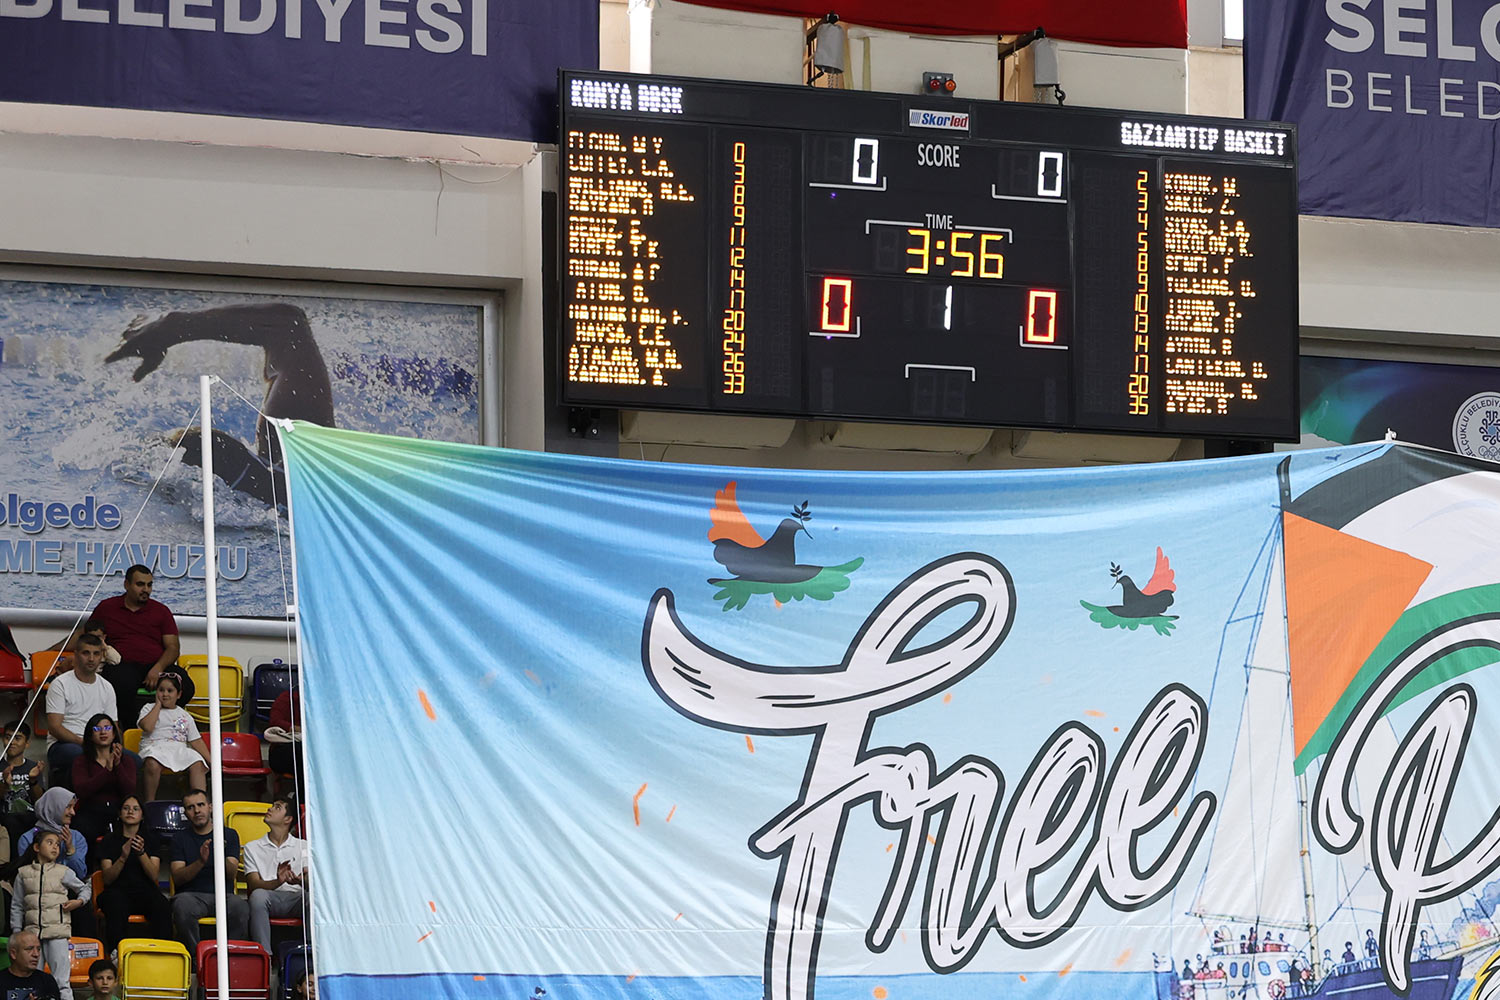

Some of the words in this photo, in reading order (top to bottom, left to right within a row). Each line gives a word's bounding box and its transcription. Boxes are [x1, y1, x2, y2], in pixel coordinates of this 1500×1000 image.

[921, 113, 969, 128] Skorled
[733, 142, 745, 163] 0
[1224, 128, 1287, 156] BASKET
[852, 138, 879, 184] 0
[917, 143, 961, 168] SCORE
[733, 164, 745, 184] 3
[1037, 151, 1064, 197] 0
[1137, 170, 1148, 191] 2
[733, 184, 745, 205] 8
[1137, 191, 1148, 211] 3
[733, 205, 745, 226] 9
[925, 213, 953, 231] TIME
[1137, 212, 1148, 231] 4
[1137, 232, 1148, 251] 5
[906, 229, 1004, 279] 3:56
[1137, 252, 1148, 272] 8
[1137, 273, 1148, 292] 9
[821, 277, 853, 332] 0
[943, 285, 953, 331] 1
[1026, 289, 1058, 344] 0
[75, 541, 249, 581] HAVUZU
